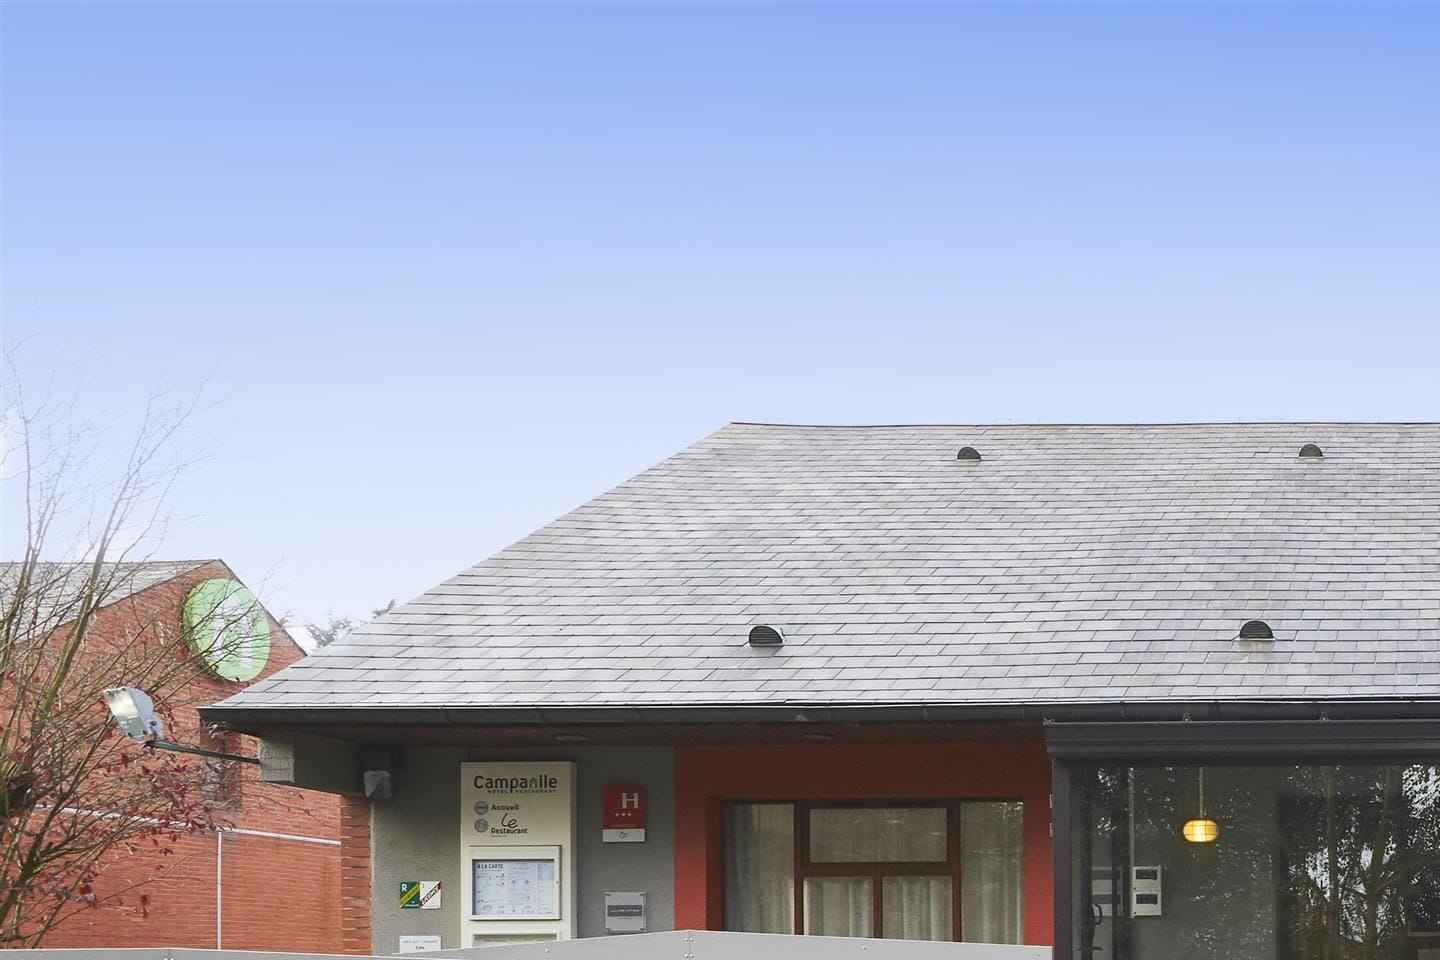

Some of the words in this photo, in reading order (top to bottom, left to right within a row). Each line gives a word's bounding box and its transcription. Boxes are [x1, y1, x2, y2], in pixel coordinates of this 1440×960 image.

[473, 774, 558, 793] Campanile
[622, 793, 639, 808] H
[501, 812, 518, 828] Le
[401, 883, 408, 892] R
